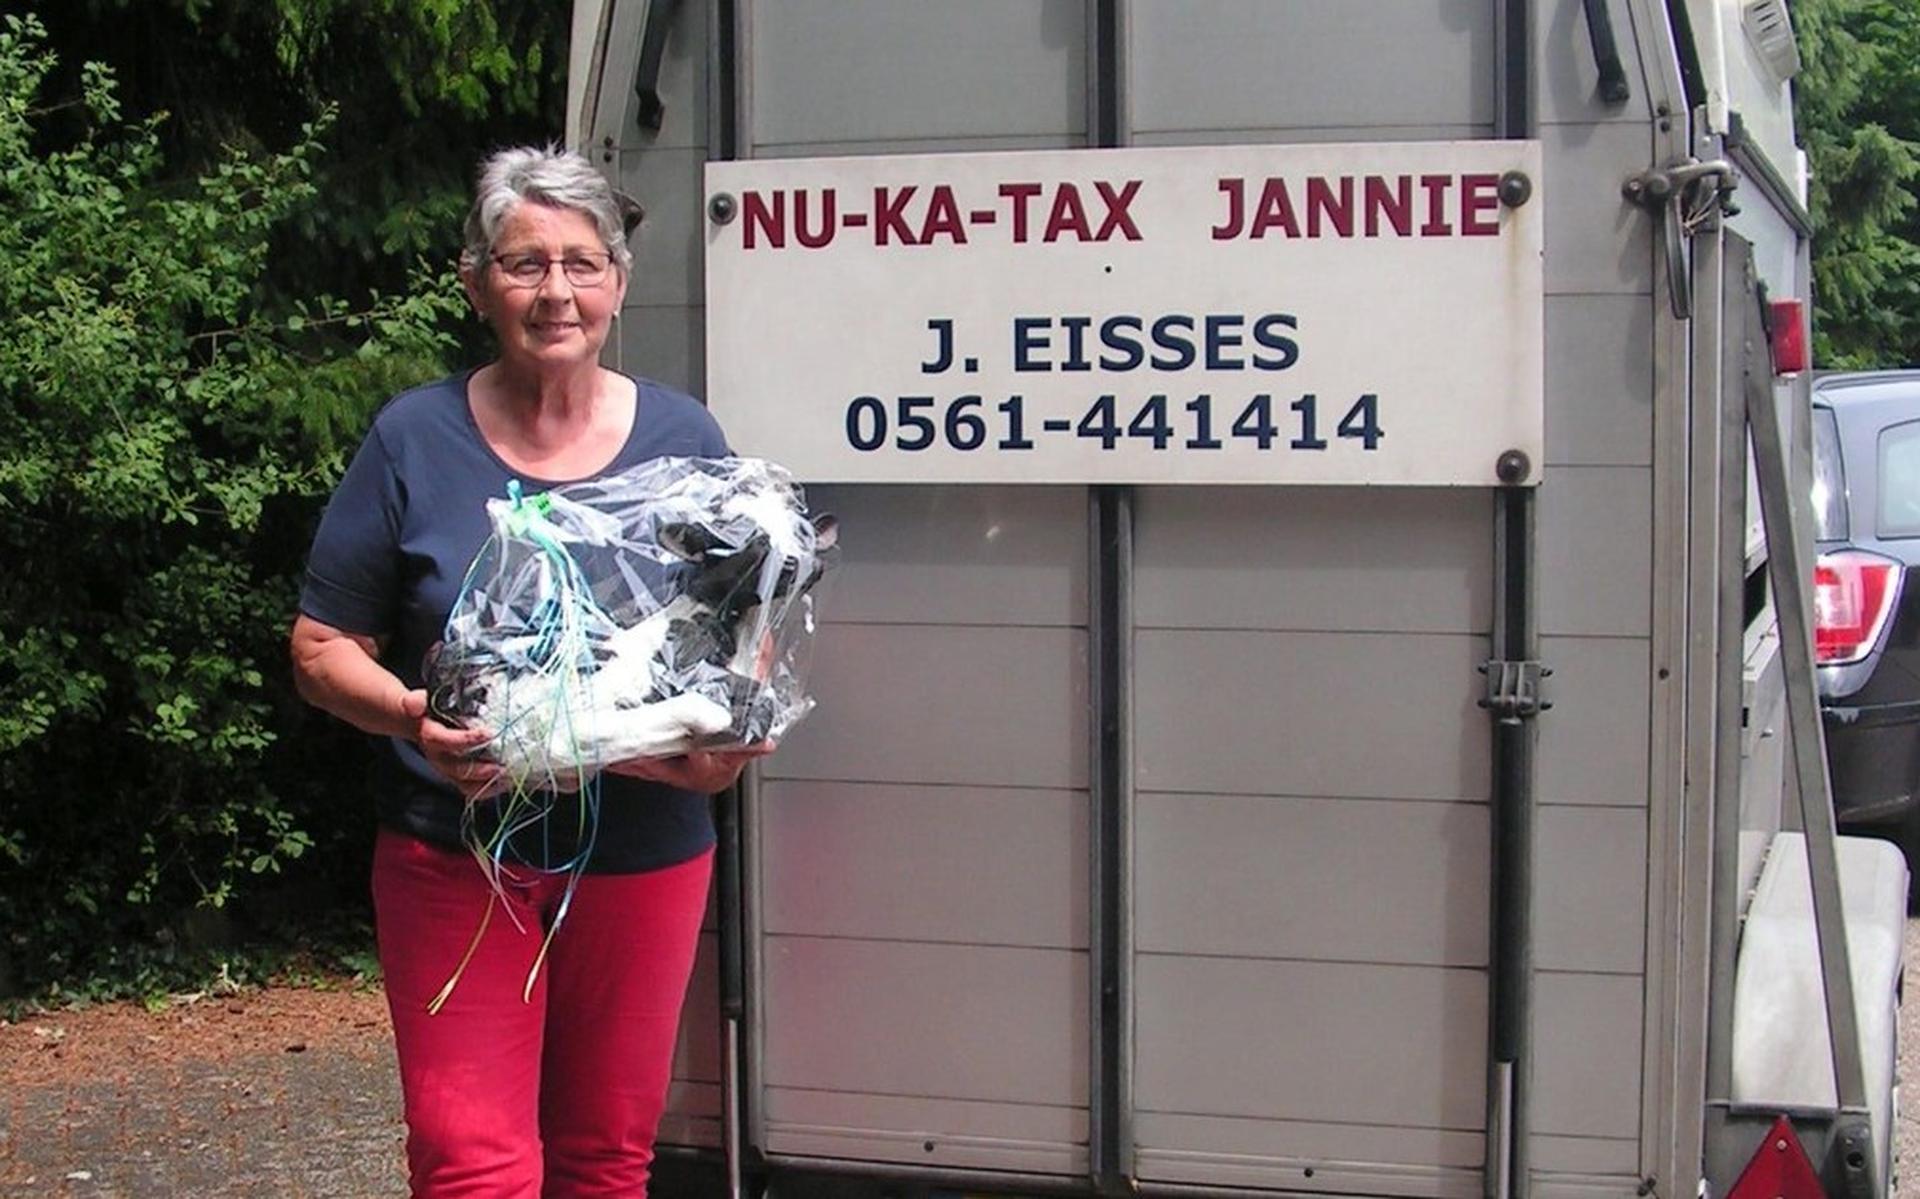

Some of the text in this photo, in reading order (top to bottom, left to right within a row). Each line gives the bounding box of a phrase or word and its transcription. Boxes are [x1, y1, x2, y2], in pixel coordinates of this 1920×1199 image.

[742, 174, 1500, 249] NU-KA-TAX JANNIE
[922, 315, 1299, 373] J. EISSES
[846, 394, 1385, 451] 0561-441414
